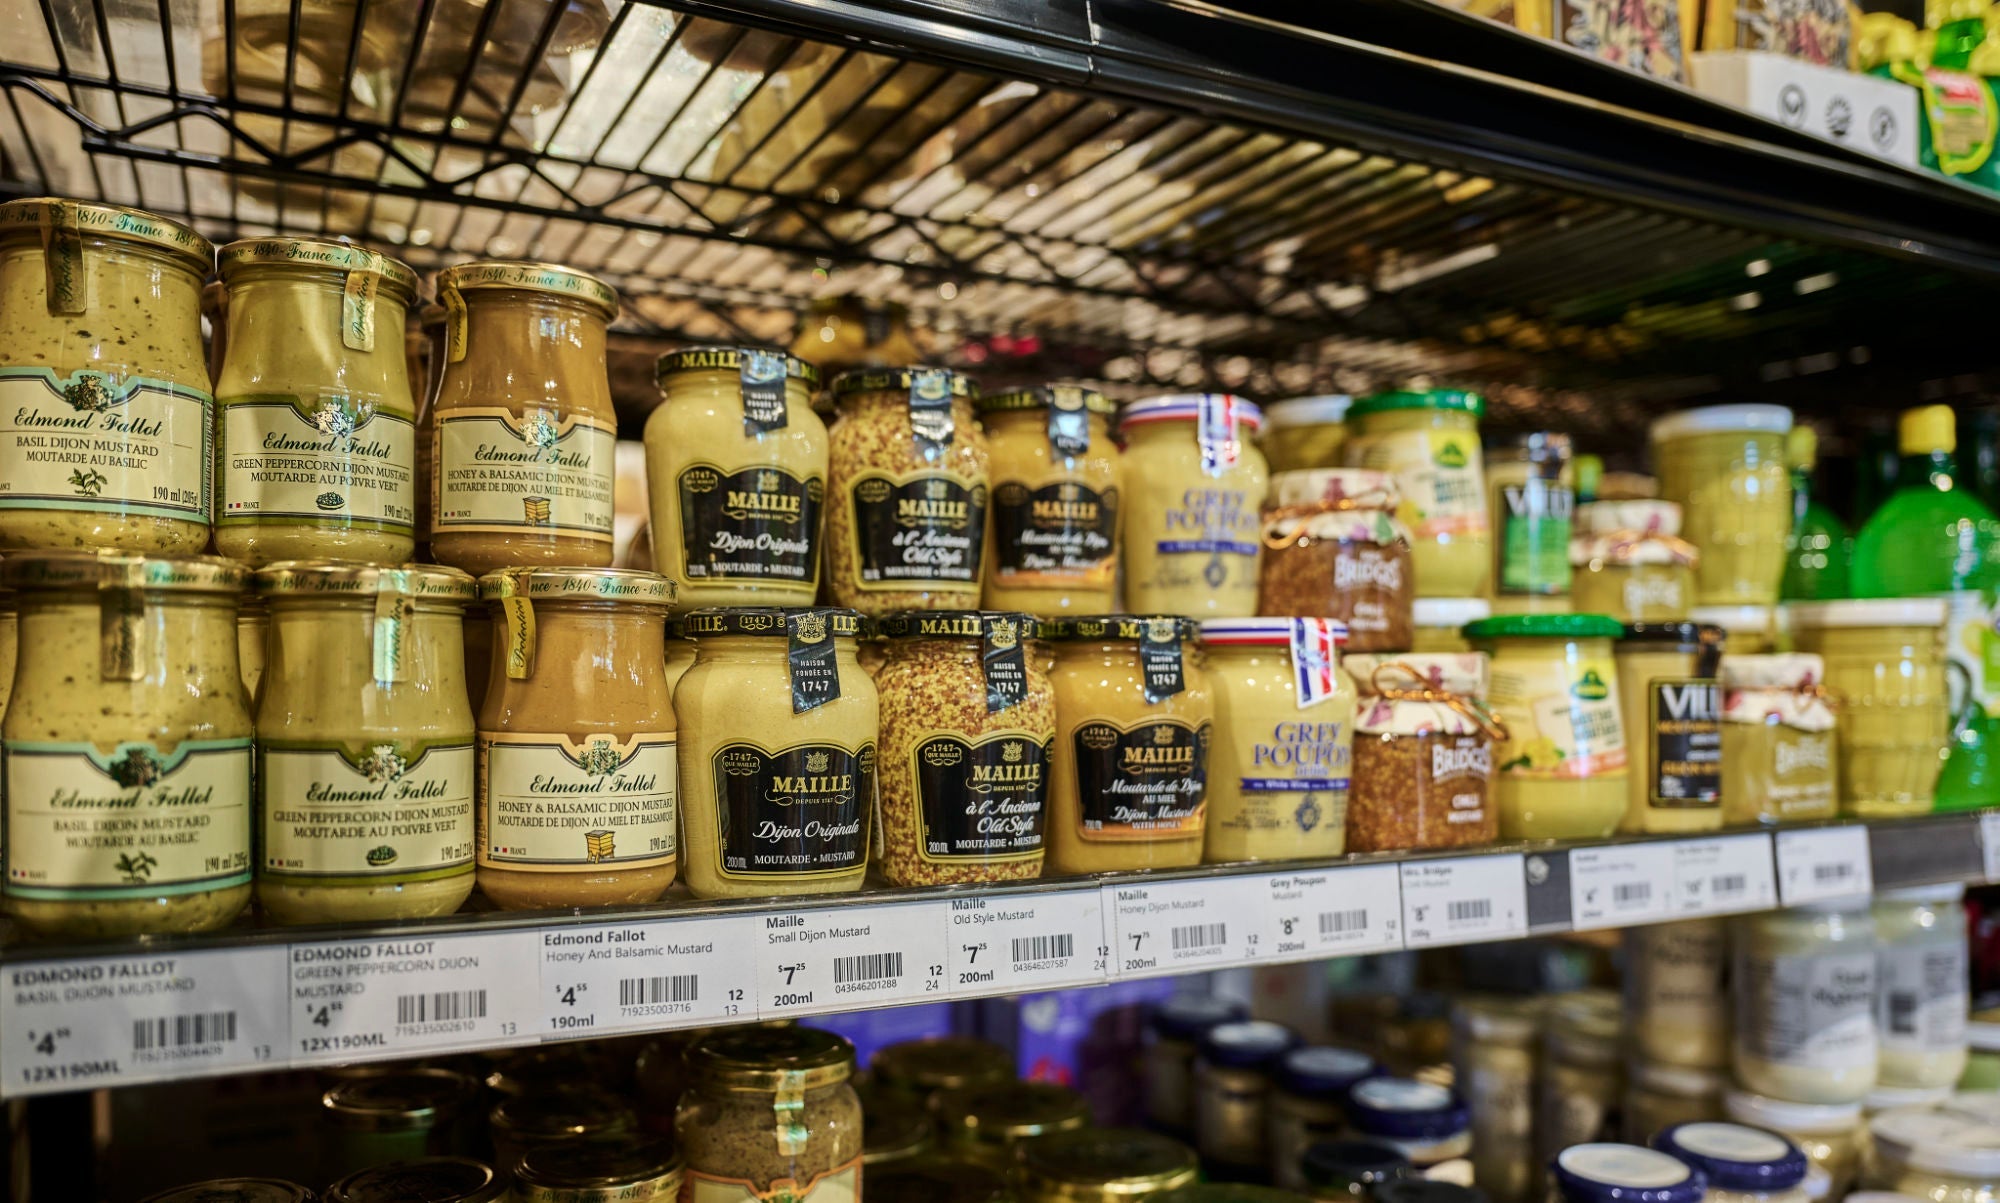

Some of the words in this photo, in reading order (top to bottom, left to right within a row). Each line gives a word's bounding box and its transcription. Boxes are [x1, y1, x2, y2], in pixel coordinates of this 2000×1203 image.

[117, 214, 164, 238] France
[287, 242, 333, 261] France
[482, 268, 506, 280] 1840
[514, 273, 554, 286] France
[14, 407, 94, 429] Edmond
[100, 413, 162, 436] Fallot
[16, 436, 47, 447] BASIL
[50, 438, 90, 452] DIJON
[94, 441, 158, 457] MUSTARD
[263, 432, 336, 452] Edmond
[342, 437, 391, 459] Fallot
[26, 451, 87, 463] MOUTARDE
[90, 454, 106, 465] AU
[109, 457, 147, 469] BASILIC
[474, 444, 541, 461] Edmond
[546, 449, 591, 469] Fallot
[233, 459, 263, 469] GREEN
[265, 459, 340, 472] PEPPERCORN
[343, 463, 374, 476] DIJON
[251, 472, 316, 483] MOUTARDE
[319, 475, 336, 485] AU
[339, 476, 376, 488] POIVRE
[379, 482, 399, 492] VERT
[448, 470, 477, 480] HONEY
[479, 471, 487, 479] &
[489, 470, 544, 482] BALSAMIC
[546, 473, 575, 485] DIJON
[153, 486, 168, 500] 190
[171, 488, 181, 502] ml
[448, 482, 487, 492] MOUTARDE
[488, 482, 500, 492] DE
[501, 482, 528, 494] DIJON
[529, 485, 543, 493] AU
[545, 485, 564, 496] MIEL
[566, 487, 575, 497] ET
[727, 491, 800, 512] MAILLE
[898, 499, 968, 518] MAILLE
[710, 531, 754, 554] Dijon
[713, 562, 762, 573] MOUTARDE
[415, 576, 453, 593] France
[562, 578, 592, 592] 1840
[599, 577, 640, 595] France
[745, 616, 766, 624] 1747
[800, 659, 826, 667] MAISON
[796, 668, 821, 677] FONDÉE
[1152, 674, 1177, 685] 1747
[801, 681, 829, 692] 1747
[996, 682, 1020, 693] 1747
[1274, 721, 1341, 744] GREY
[932, 744, 953, 752] 1747
[1124, 746, 1194, 763] MAILLE
[729, 753, 751, 761] 1747
[973, 763, 1040, 781] MAILLE
[306, 782, 388, 801] Edmond
[394, 779, 447, 799] Fallot
[530, 774, 604, 793] Edmond
[609, 773, 656, 792] Fallot
[772, 775, 852, 793] MAILLE
[1102, 779, 1164, 794] Moutarde
[49, 787, 141, 809] Edmond
[150, 785, 213, 807] Fallot
[274, 811, 307, 822] GREEN
[310, 810, 392, 823] PEPPERCORN
[395, 809, 430, 823] DIJON
[432, 803, 469, 817] MUSTARD
[499, 801, 533, 814] HONEY
[535, 804, 544, 813] &
[547, 803, 607, 813] BALSAMIC
[609, 801, 639, 815] DIJON
[642, 797, 673, 810] MUSTARD
[966, 802, 976, 815] à
[498, 815, 544, 827] MOUTARDE
[546, 816, 559, 827] DE
[561, 816, 590, 830] DIJON
[593, 816, 605, 827] AU
[608, 816, 627, 826] MIEL
[630, 814, 639, 825] ET
[1110, 806, 1148, 823] Dijon
[141, 815, 210, 831] MUSTARD
[293, 826, 365, 839] MOUTARDE
[369, 826, 388, 837] AU
[391, 822, 432, 836] POIVRE
[434, 820, 456, 832] VERT
[752, 821, 802, 843] Dijon
[804, 818, 859, 841] Originale
[977, 817, 1004, 833] Old
[955, 838, 1006, 849] MOUTARDE
[755, 855, 810, 865] MOUTARDE
[820, 851, 855, 863] MUSTARD
[1270, 878, 1290, 889] Grey
[1293, 876, 1326, 886] Poupon
[1118, 889, 1148, 901] Maille
[952, 898, 986, 911] Maille
[1120, 905, 1146, 914] Honey
[1148, 902, 1170, 913] Dijon
[1171, 900, 1204, 910] Mustard
[766, 915, 804, 929] Maille
[954, 913, 971, 925] Old
[973, 912, 995, 925] Style
[997, 909, 1034, 921] Mustard
[545, 932, 603, 946] Edmond
[607, 930, 646, 943] Fallot
[768, 931, 796, 944] Small
[799, 929, 827, 943] Dijon
[829, 925, 870, 938] Mustard
[1247, 934, 1258, 945] 12
[293, 945, 371, 963] EDMOND
[376, 941, 435, 957] FALLOT
[546, 951, 584, 963] Honey
[588, 947, 612, 960] And
[615, 945, 664, 958] Balsamic
[667, 942, 713, 955] Mustard
[1097, 946, 1109, 957] 12
[1278, 941, 1304, 953] 200ml
[295, 965, 342, 980] GREEN
[346, 958, 435, 976] PEPPERCORN
[929, 965, 942, 976] 12
[1013, 959, 1068, 972] 043646207587
[1094, 960, 1106, 970] 24
[1125, 957, 1156, 970] 200ml
[13, 965, 104, 987] EDMOND
[109, 960, 176, 979] FALLOT
[959, 970, 994, 984] 200ml
[119, 977, 195, 996] MUSTARD
[295, 982, 364, 998] MUSTARD
[835, 979, 897, 994] 043646201288
[925, 979, 939, 991] 24
[728, 989, 744, 1001] 12
[774, 991, 813, 1006] 200ml
[620, 1003, 691, 1017] 719235003716
[724, 1004, 739, 1016] 13
[501, 1022, 517, 1035] 13
[551, 1014, 595, 1029] 190ml
[300, 1033, 387, 1052] 12X190ML
[253, 1045, 271, 1060] 13
[23, 1060, 121, 1083] 12X190ML
